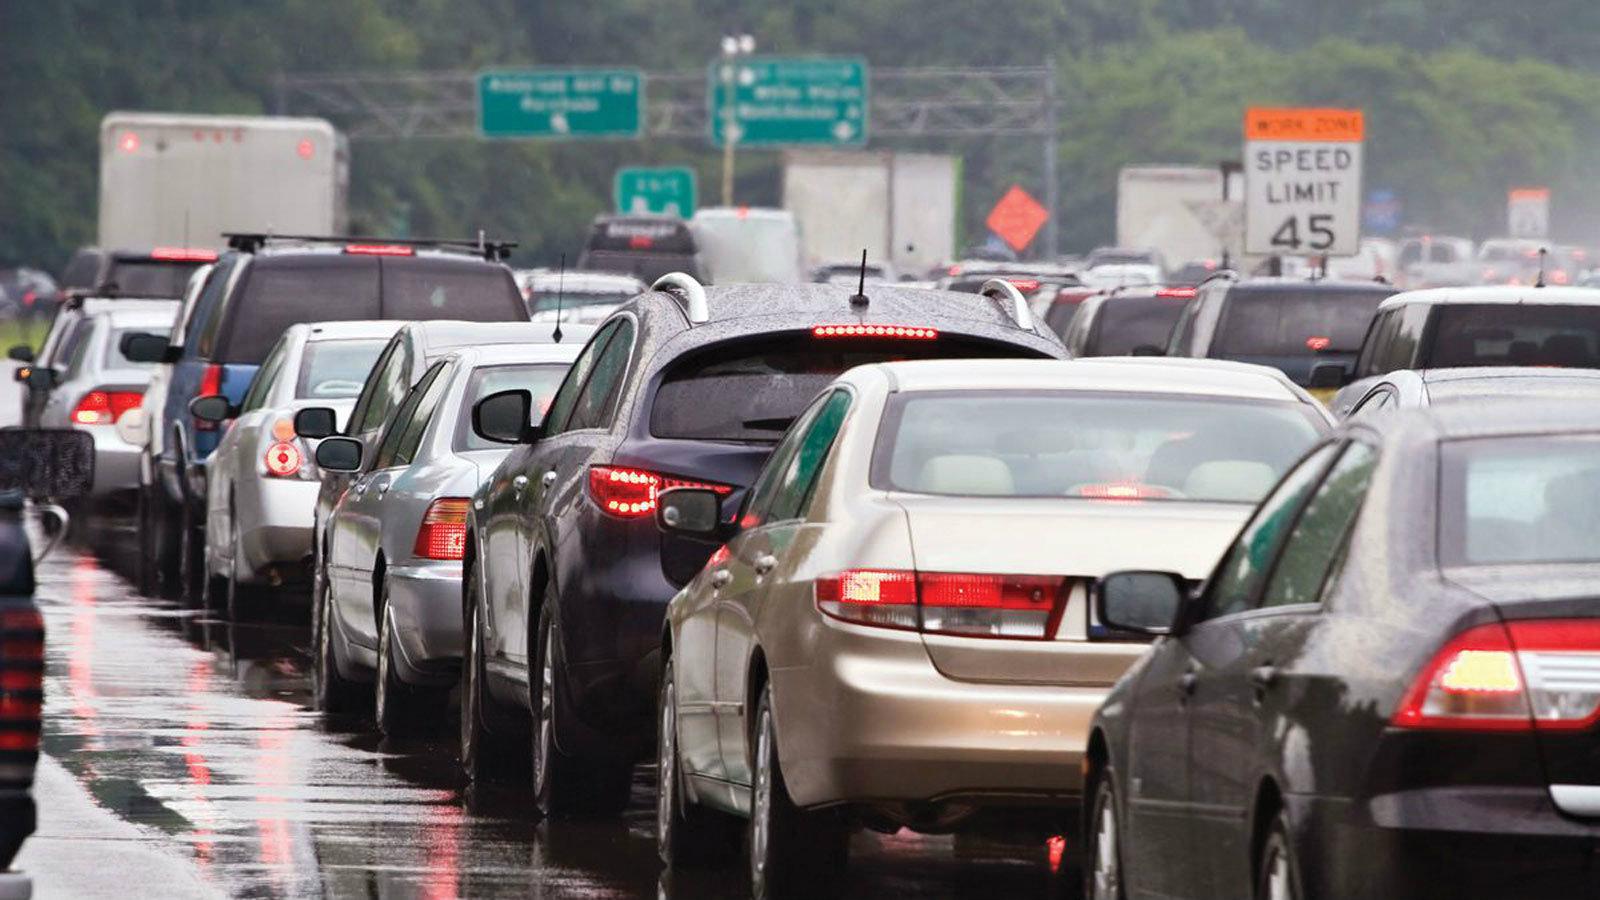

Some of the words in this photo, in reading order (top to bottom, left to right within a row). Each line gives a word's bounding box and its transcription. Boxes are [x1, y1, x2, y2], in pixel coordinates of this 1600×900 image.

[1257, 118, 1302, 135] WORK
[1257, 150, 1352, 171] SPEED
[1267, 181, 1340, 203] LIMIT
[1271, 214, 1335, 249] 45
